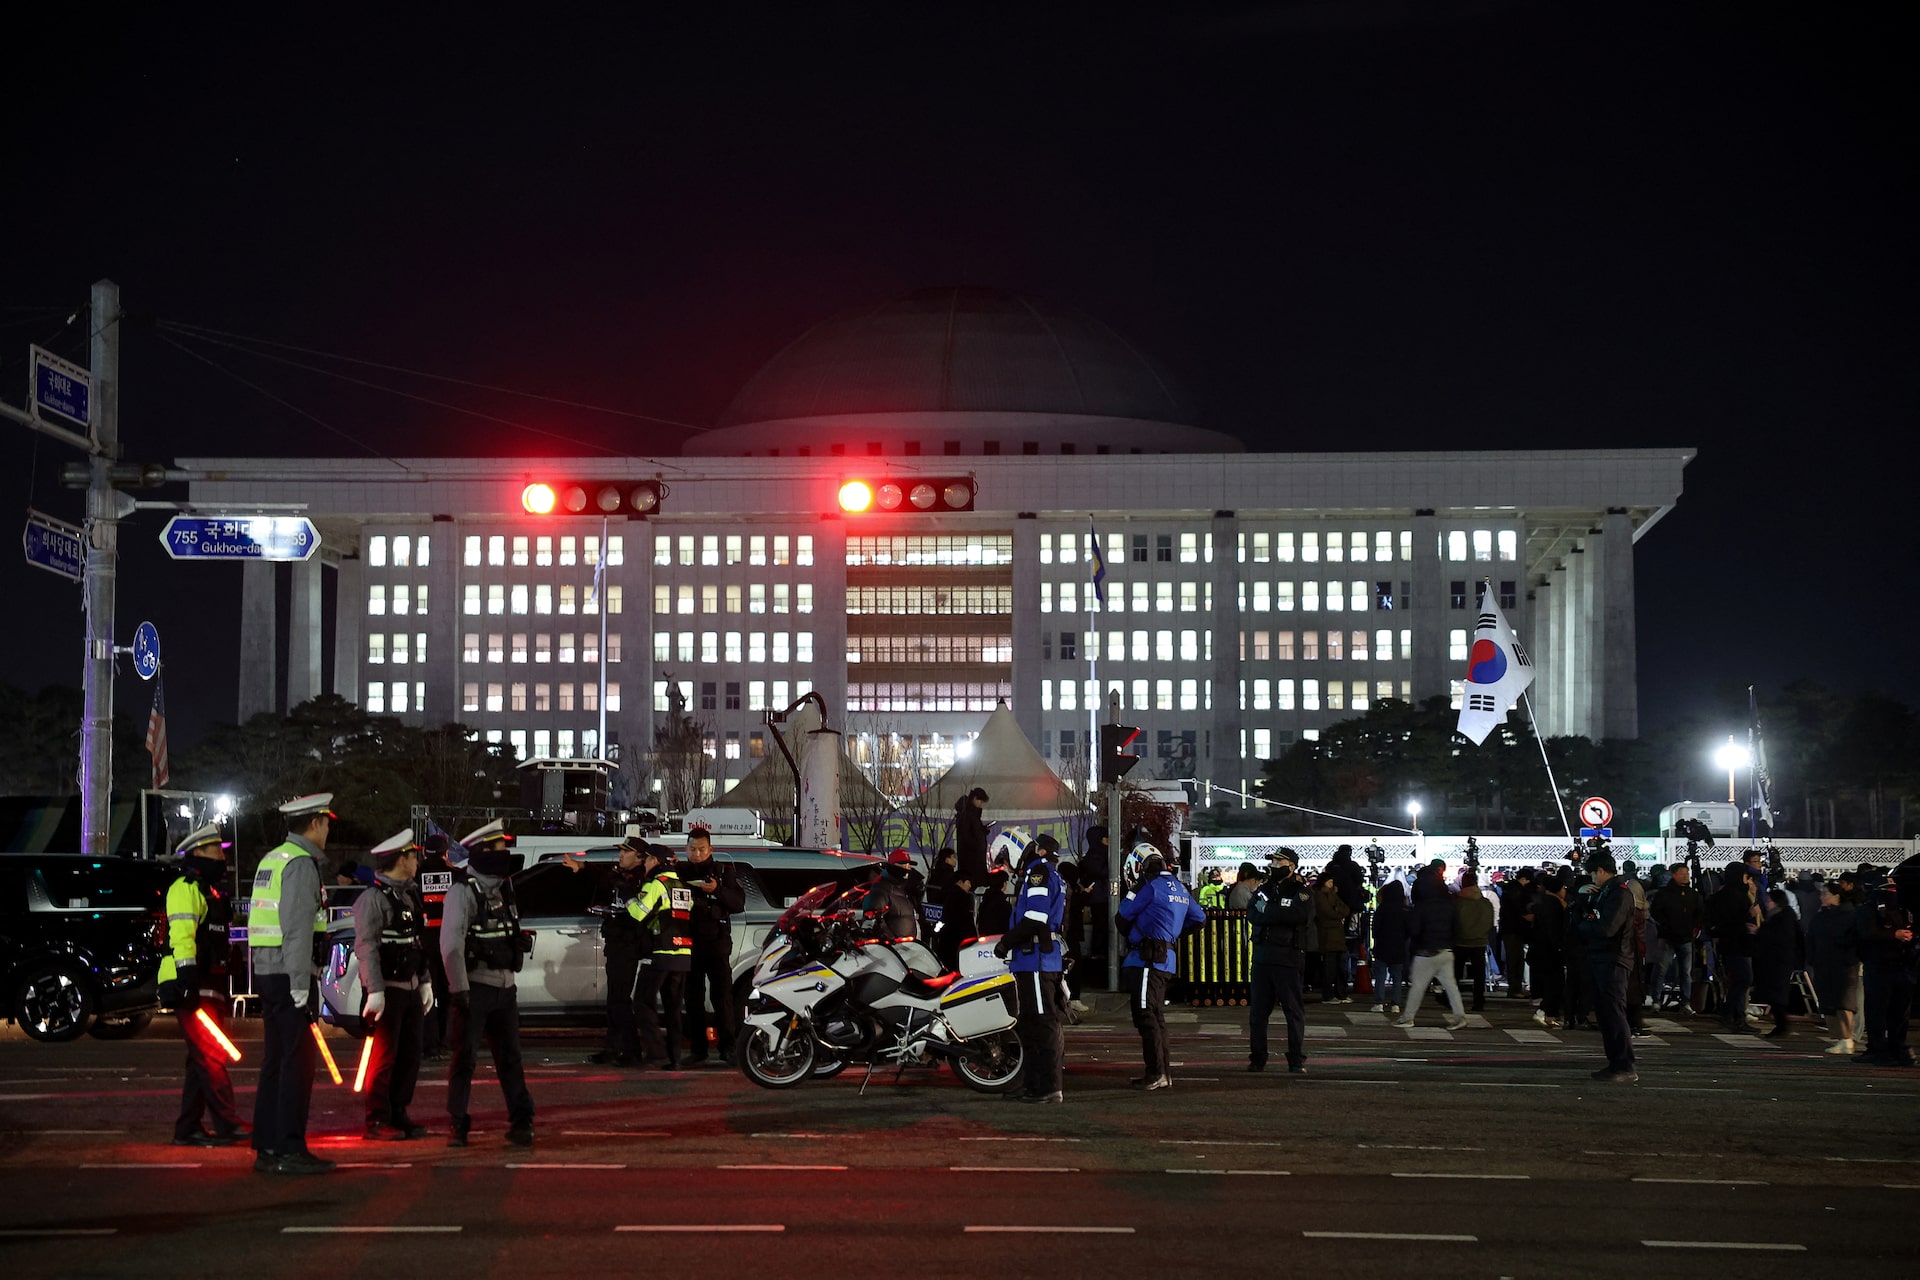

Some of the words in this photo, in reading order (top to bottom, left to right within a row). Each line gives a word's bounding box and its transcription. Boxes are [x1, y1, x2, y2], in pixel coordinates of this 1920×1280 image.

[47, 371, 72, 397] 국회대로
[173, 531, 198, 544] 755
[204, 521, 266, 539] 국회대
[42, 531, 79, 560] 의사당대로
[201, 541, 268, 553] Gukhoe-da
